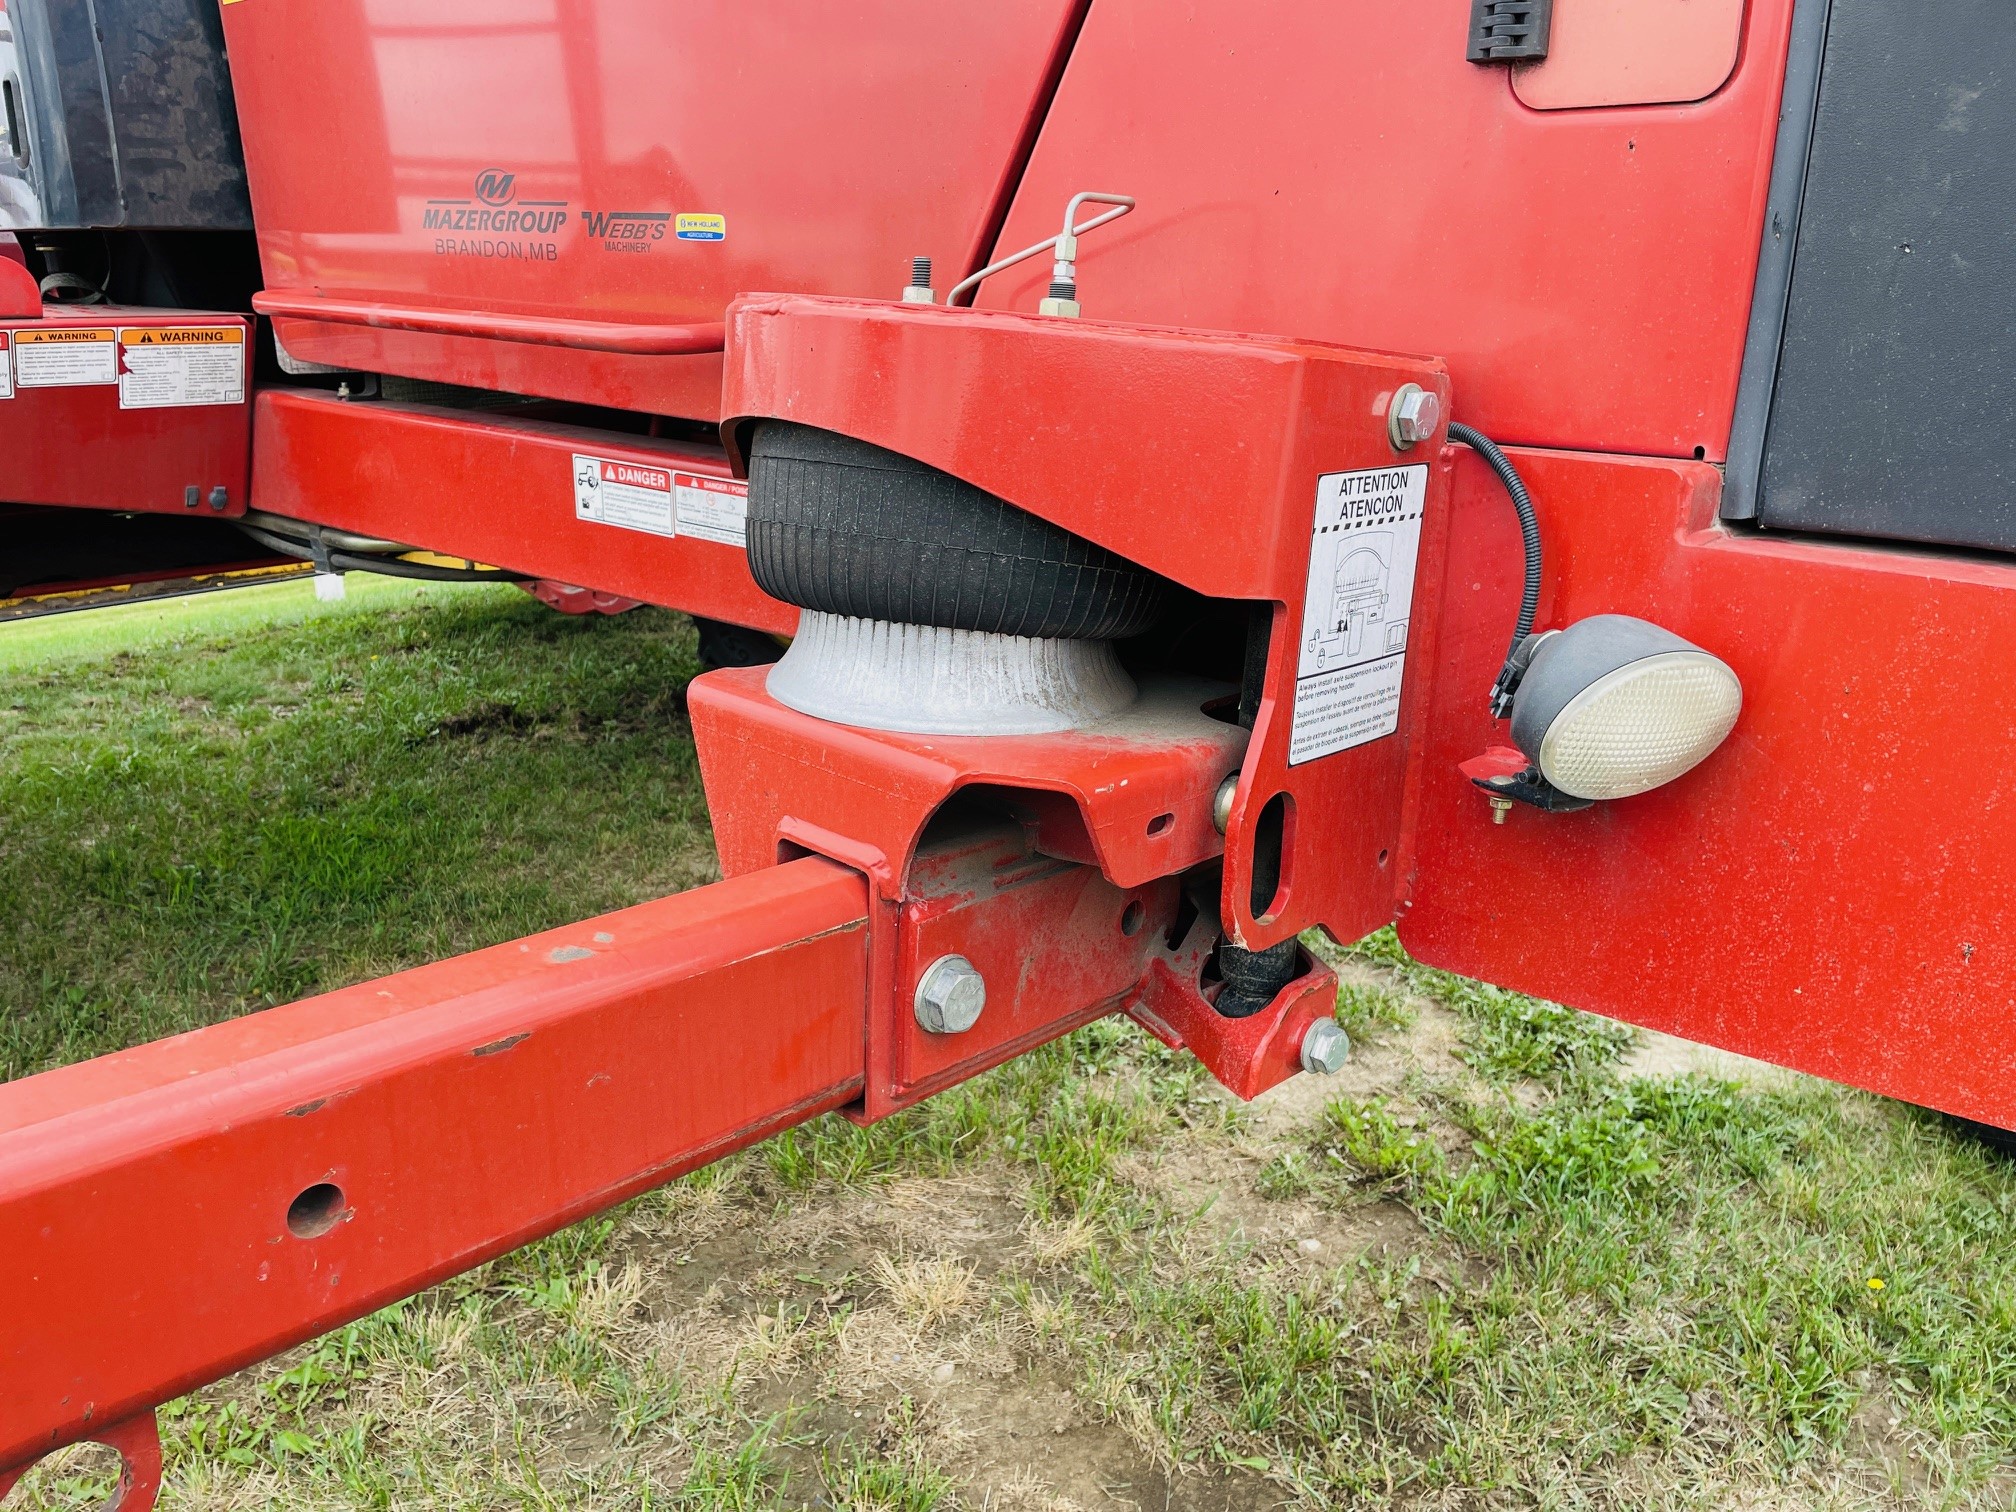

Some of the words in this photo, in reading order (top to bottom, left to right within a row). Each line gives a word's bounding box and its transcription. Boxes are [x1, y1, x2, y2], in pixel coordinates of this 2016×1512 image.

[423, 208, 567, 234] MAZERGROUP
[581, 211, 667, 240] WEBB'S
[604, 241, 651, 253] MACHINERY
[48, 332, 97, 341] WARNING
[159, 331, 224, 342] WARNING
[617, 467, 666, 489] DANGER
[703, 480, 728, 492] DANGER
[1339, 471, 1409, 497] ATTENTION
[1339, 490, 1404, 520] ATENCIÓN
